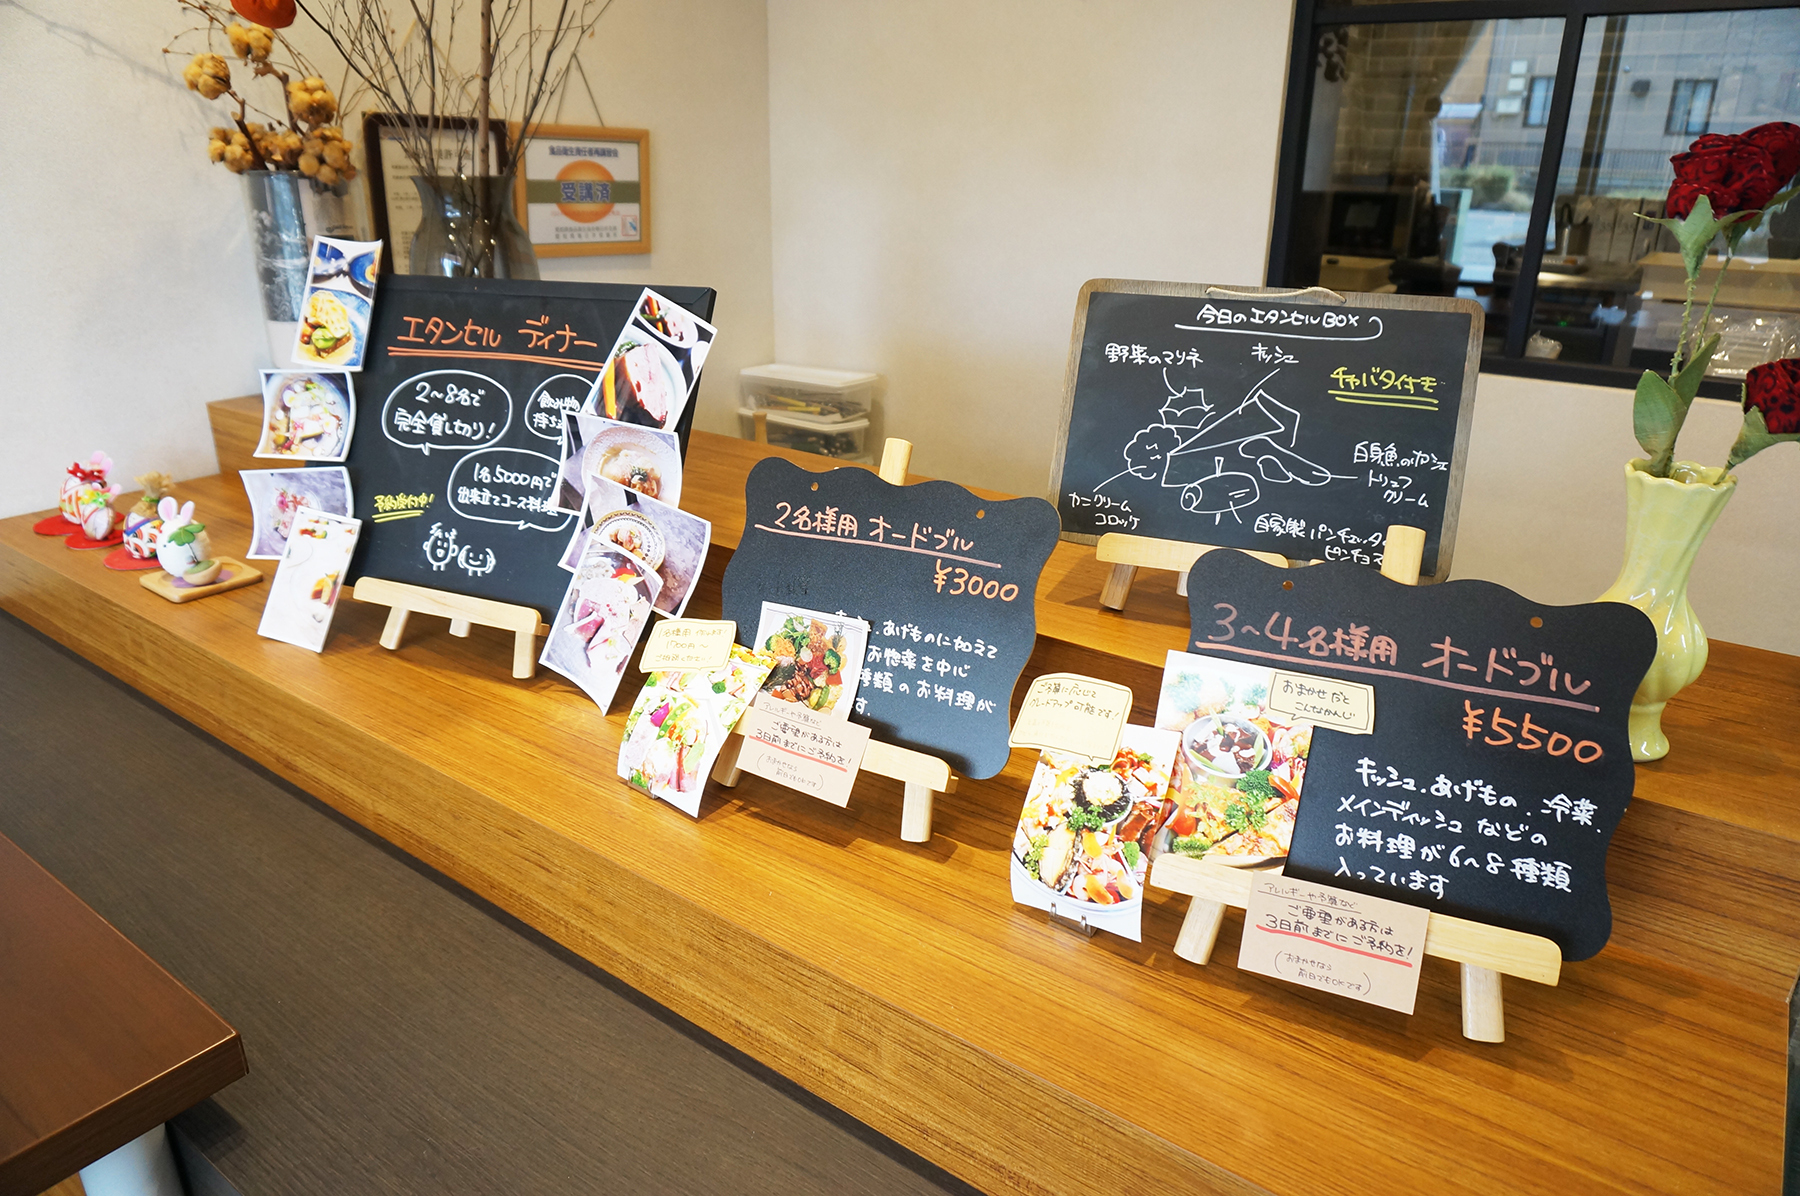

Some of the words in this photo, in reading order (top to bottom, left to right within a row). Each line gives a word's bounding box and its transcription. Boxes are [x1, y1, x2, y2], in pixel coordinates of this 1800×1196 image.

[561, 182, 612, 203] 受講済
[397, 316, 502, 348] エタンセル
[518, 314, 598, 353] ディナー
[1104, 342, 1204, 368] 野菜のマリネ
[1251, 342, 1299, 364] キッシュ
[1330, 366, 1438, 394] チャバタ付き
[473, 462, 558, 491] 1名5000円で
[1368, 469, 1412, 489] トリュフ
[1383, 489, 1429, 508] クリーム
[774, 501, 858, 538] 2名様用
[869, 515, 975, 551] オードブル
[1095, 513, 1140, 530] コロッケ
[933, 558, 1020, 602] ¥3000
[1421, 635, 1592, 696] オードブル
[1295, 701, 1356, 720] こんなかんじ
[1462, 699, 1604, 764] ¥5500
[1334, 856, 1449, 899] 入っています
[1287, 904, 1394, 937] ご要望がある方は
